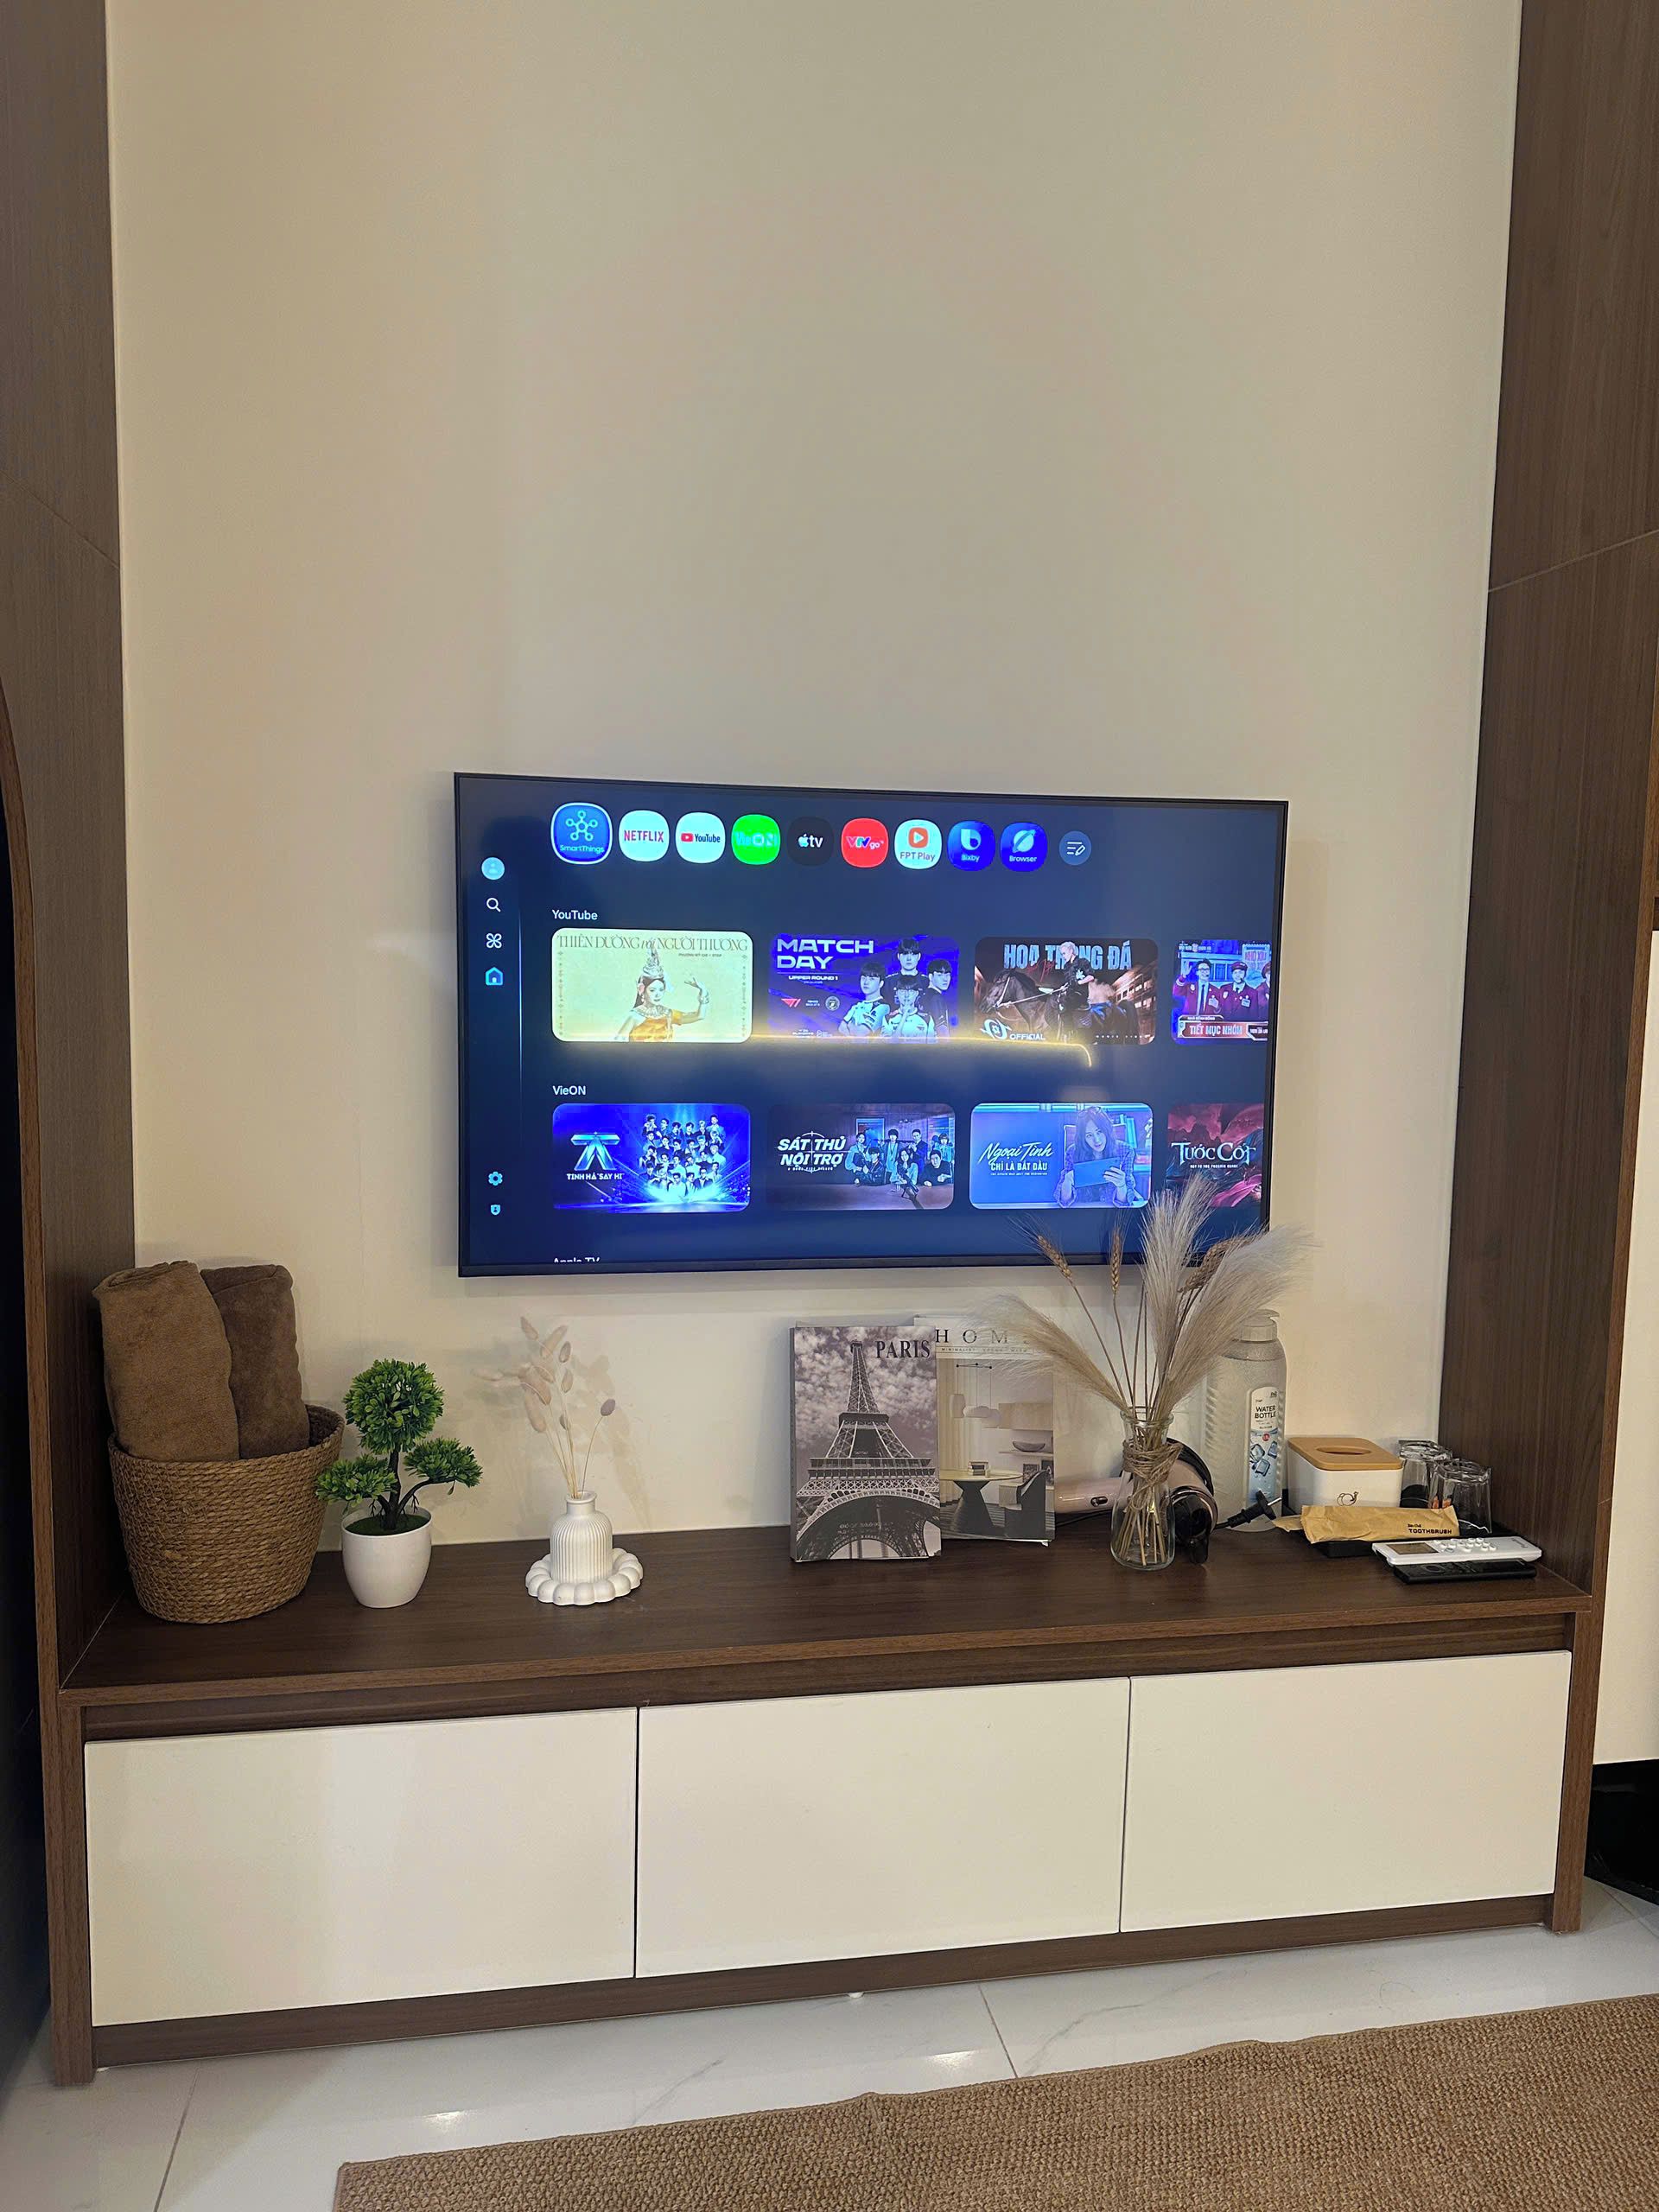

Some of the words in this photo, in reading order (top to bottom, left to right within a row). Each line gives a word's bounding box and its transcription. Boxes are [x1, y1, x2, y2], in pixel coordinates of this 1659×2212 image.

[624, 830, 664, 842] NETFLIX
[695, 834, 721, 843] YouTube
[560, 844, 605, 855] SmartThings
[918, 852, 936, 862] Play
[961, 854, 980, 862] Bixby
[552, 909, 598, 920] YouTube
[777, 938, 874, 954] MATCH
[777, 955, 833, 969] DAY
[1004, 944, 1039, 969] HOA
[1046, 944, 1103, 970] TRNG
[1108, 940, 1132, 970] ĐÁ
[553, 1085, 587, 1096] VieON
[778, 1136, 811, 1151] SÁT
[815, 1135, 847, 1151] THỦ
[780, 1152, 810, 1167] NỘI
[813, 1153, 844, 1167] TRỢ
[978, 1142, 1023, 1166] Ngoại
[1020, 1141, 1054, 1161] Tình
[1171, 1141, 1216, 1166] Tước
[935, 1329, 1031, 1344] HOM
[875, 1338, 931, 1359] PARIS
